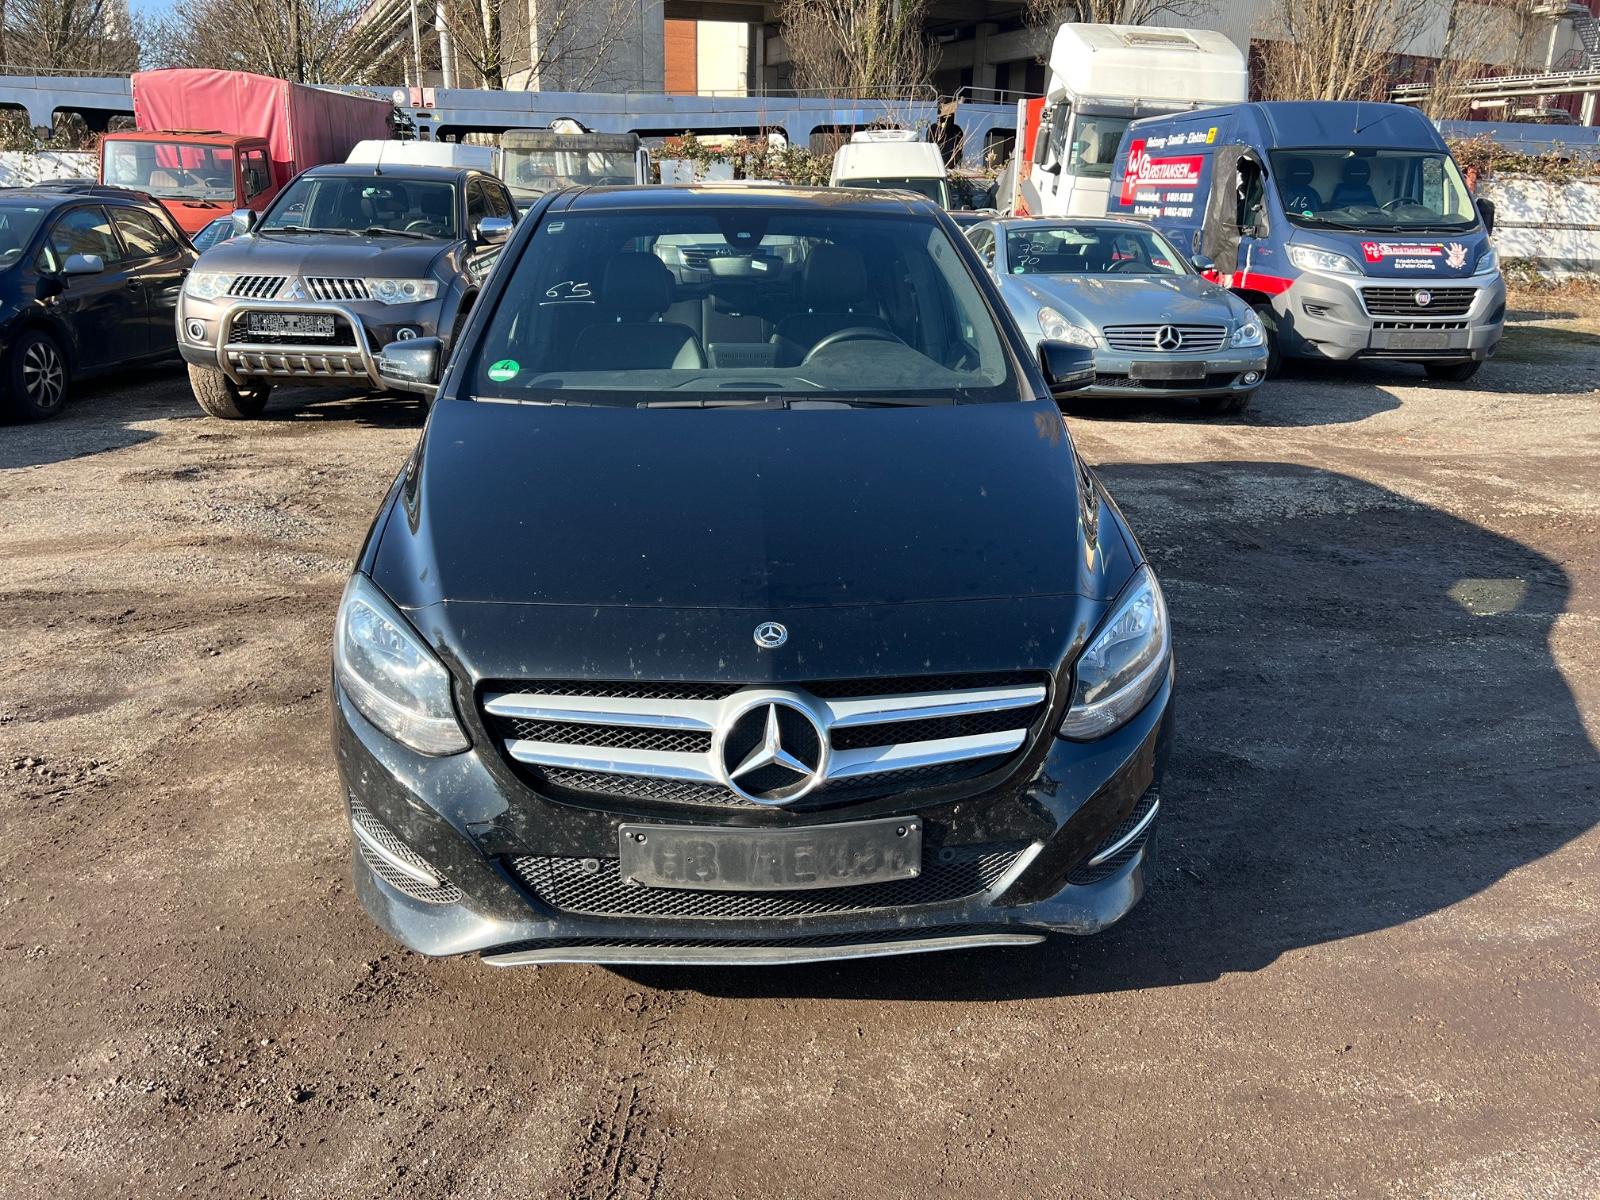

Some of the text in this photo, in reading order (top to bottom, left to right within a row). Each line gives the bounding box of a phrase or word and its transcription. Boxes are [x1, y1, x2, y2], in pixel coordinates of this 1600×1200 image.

[1019, 243, 1044, 254] 70
[1017, 255, 1040, 266] 70
[546, 280, 592, 299] 65
[501, 361, 511, 371] 4
